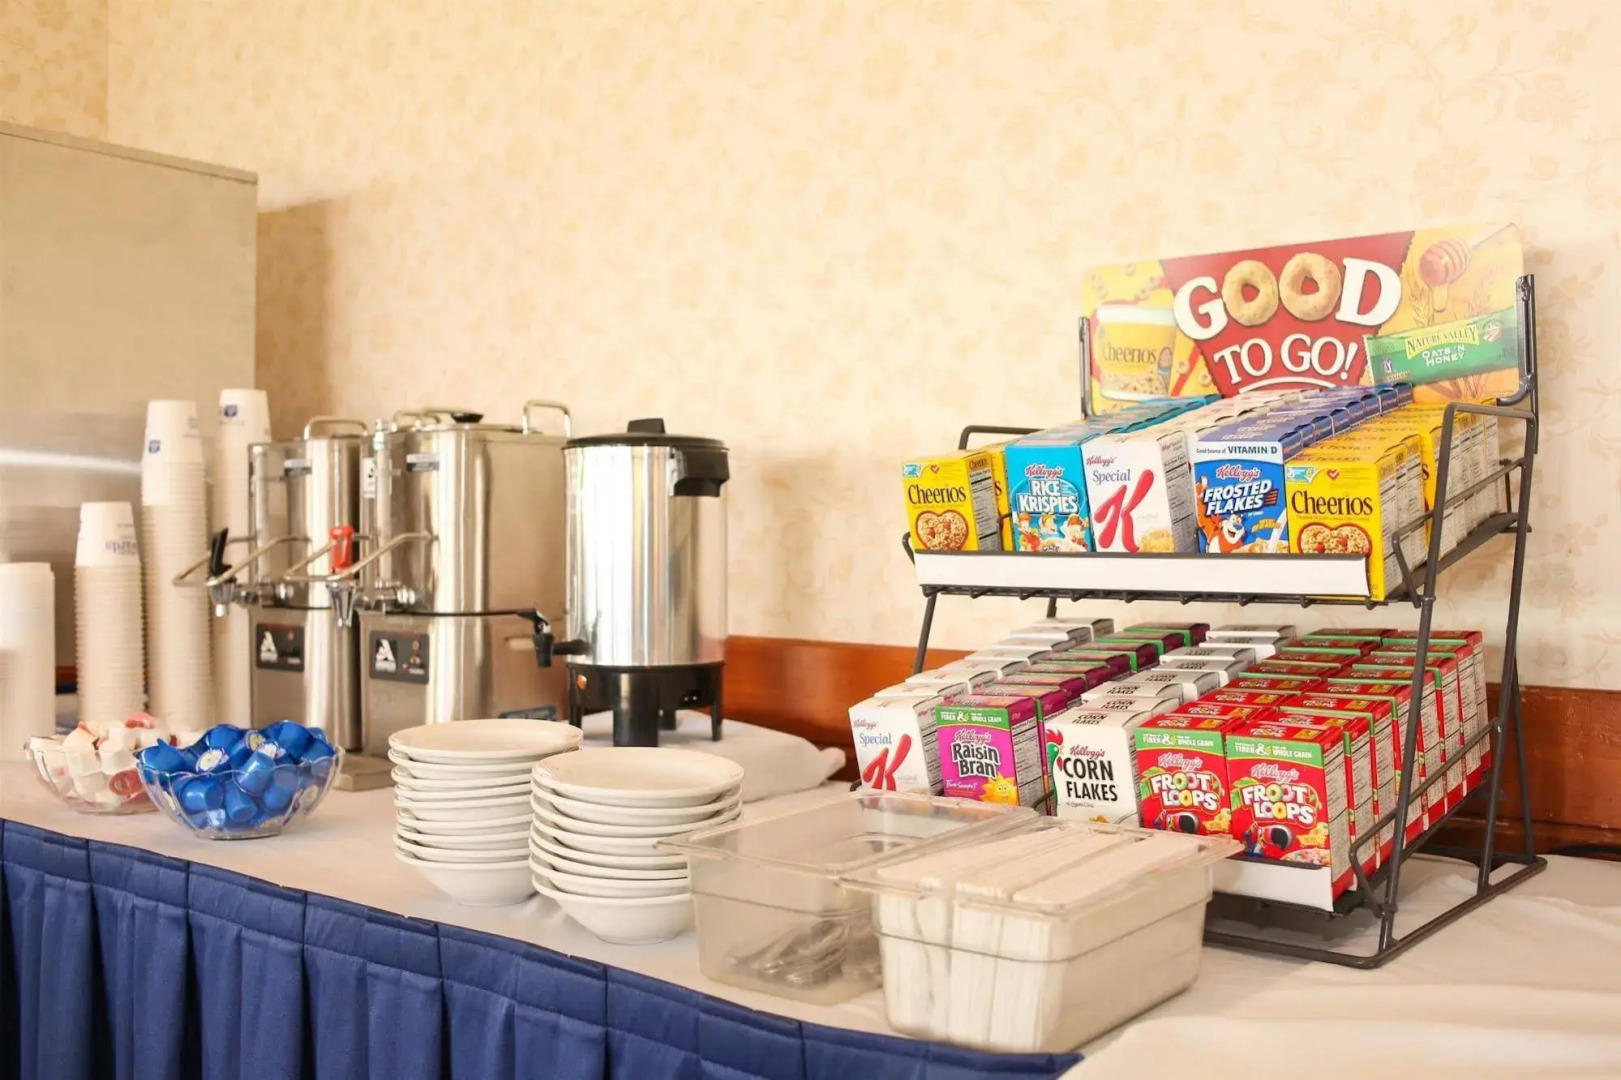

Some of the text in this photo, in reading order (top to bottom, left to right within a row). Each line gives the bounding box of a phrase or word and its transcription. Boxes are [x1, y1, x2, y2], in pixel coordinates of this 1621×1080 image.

[1173, 251, 1401, 340] GOOD
[1407, 324, 1477, 356] NATURE VALLEY
[1103, 342, 1157, 364] Cheerios
[1213, 334, 1359, 384] TO GO!
[1422, 347, 1451, 359] OATS
[1425, 352, 1465, 367] HONEY
[1227, 446, 1268, 454] VITAMIN
[1271, 446, 1278, 454] D
[1086, 455, 1115, 467] Kellogg's
[1025, 464, 1063, 480] Kellogg's
[1092, 469, 1131, 485] Special
[1217, 465, 1261, 482] Kellogg's
[908, 484, 967, 505] Cheerios
[1031, 480, 1060, 496] RICE
[1203, 480, 1272, 503] FROSTED
[1019, 494, 1078, 513] KRISPIES
[1094, 469, 1154, 553] K
[1206, 495, 1265, 516] FLAKES
[1291, 490, 1373, 516] Cheerios
[859, 733, 892, 747] Special
[862, 734, 912, 791] K
[952, 743, 999, 763] Raisin
[1070, 745, 1105, 759] Kellogg's
[1158, 752, 1202, 772] Kellogg's
[960, 760, 996, 778] Bran
[1063, 757, 1114, 781] CORN
[1251, 763, 1299, 784] Kellogg's
[1066, 781, 1118, 802] FLAKES
[1151, 772, 1211, 793] FROOT
[1162, 789, 1218, 811] LOOPS
[1242, 784, 1307, 805] FROOT
[1254, 801, 1314, 824] LOOPS
